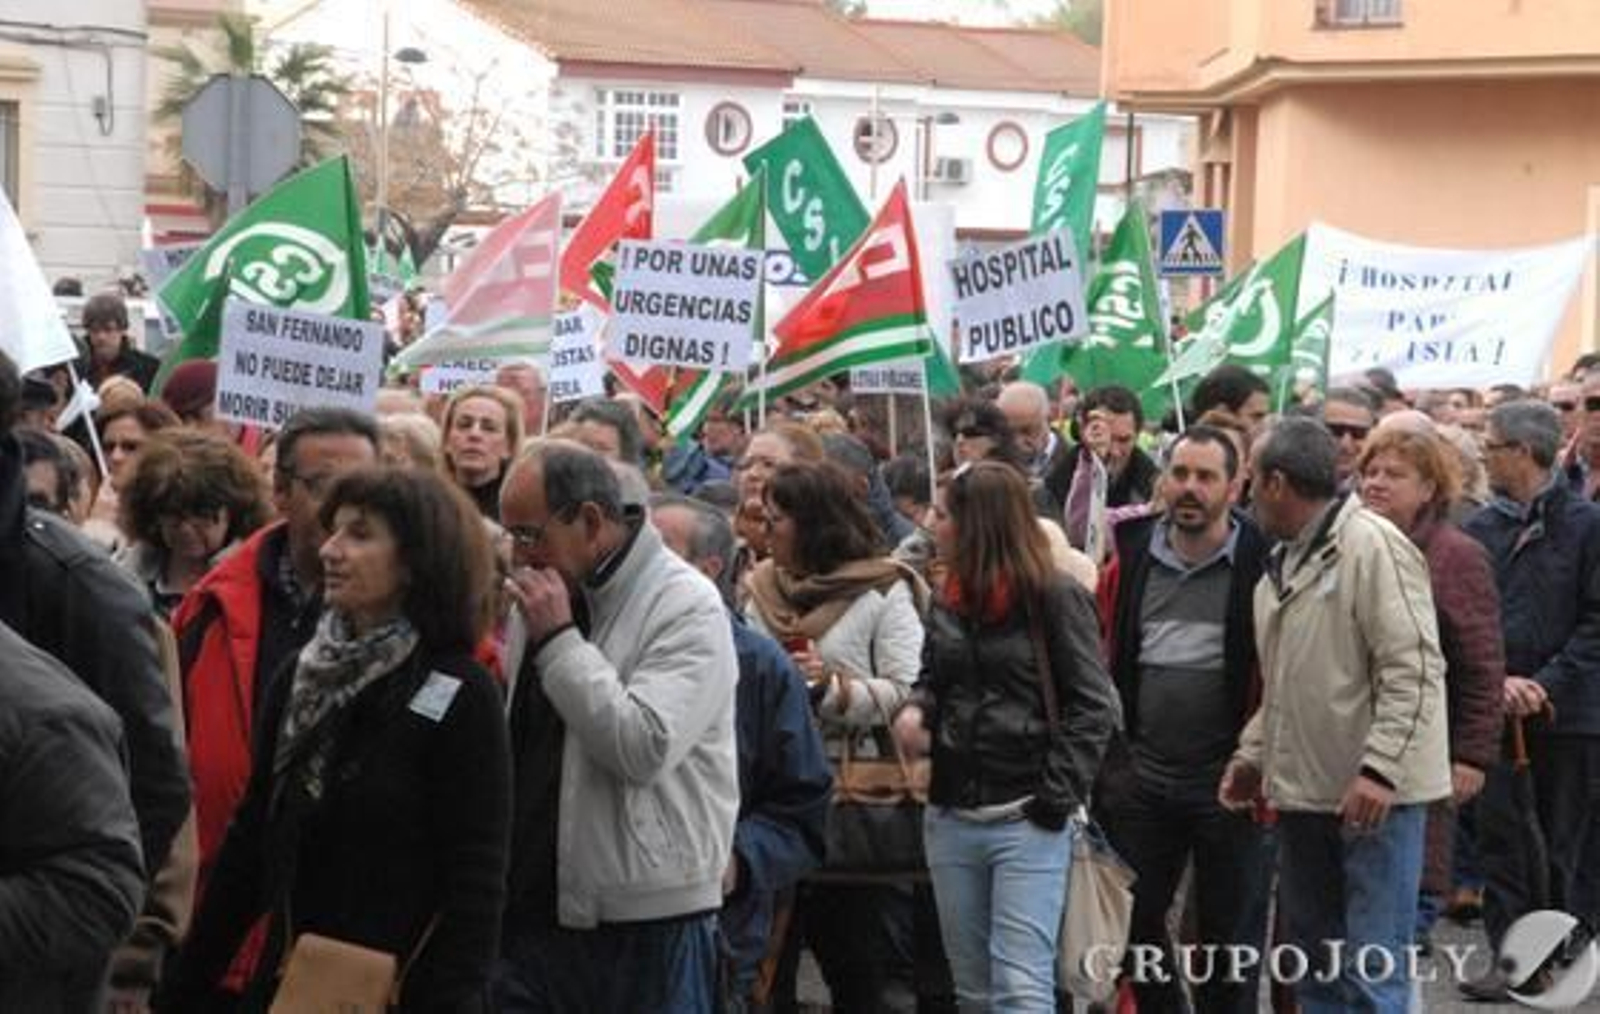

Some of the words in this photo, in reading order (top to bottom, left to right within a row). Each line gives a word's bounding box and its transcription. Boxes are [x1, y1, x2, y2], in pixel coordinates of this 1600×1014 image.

[634, 247, 683, 274] POR
[690, 252, 757, 280] UNAS
[953, 236, 1071, 300] HOSPITAL
[615, 290, 751, 324] URGENCIAS
[246, 310, 277, 336] SAN
[281, 315, 363, 352] FERNANDO
[968, 300, 1074, 357] PUBLICO
[624, 333, 714, 364] DIGNAS
[235, 351, 258, 377] NO
[262, 356, 312, 386] PUEDE
[316, 365, 364, 395] DEJAR
[219, 391, 269, 422] MORIR
